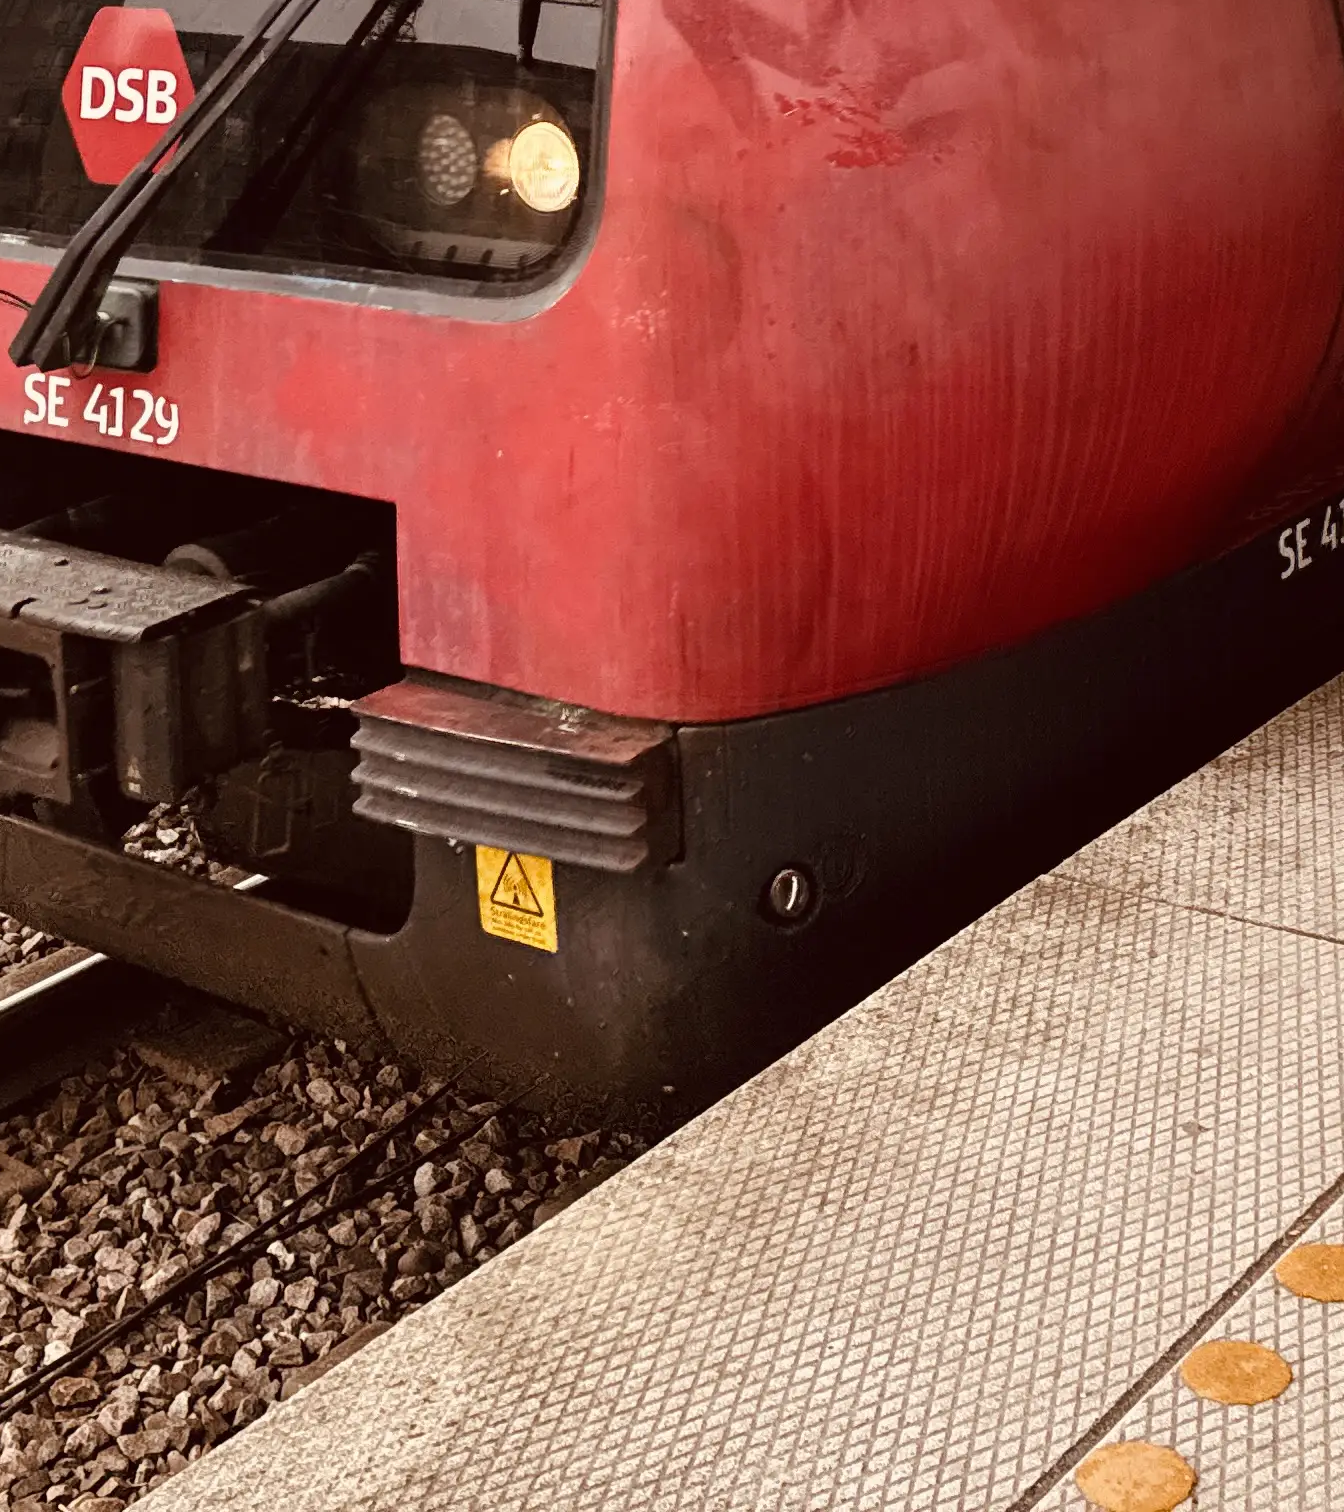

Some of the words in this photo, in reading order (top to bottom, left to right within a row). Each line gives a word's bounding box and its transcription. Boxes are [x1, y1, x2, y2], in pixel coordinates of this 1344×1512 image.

[79, 65, 177, 125] DSB
[23, 372, 71, 428] SE
[83, 383, 180, 445] 4129
[1278, 518, 1313, 580] SE
